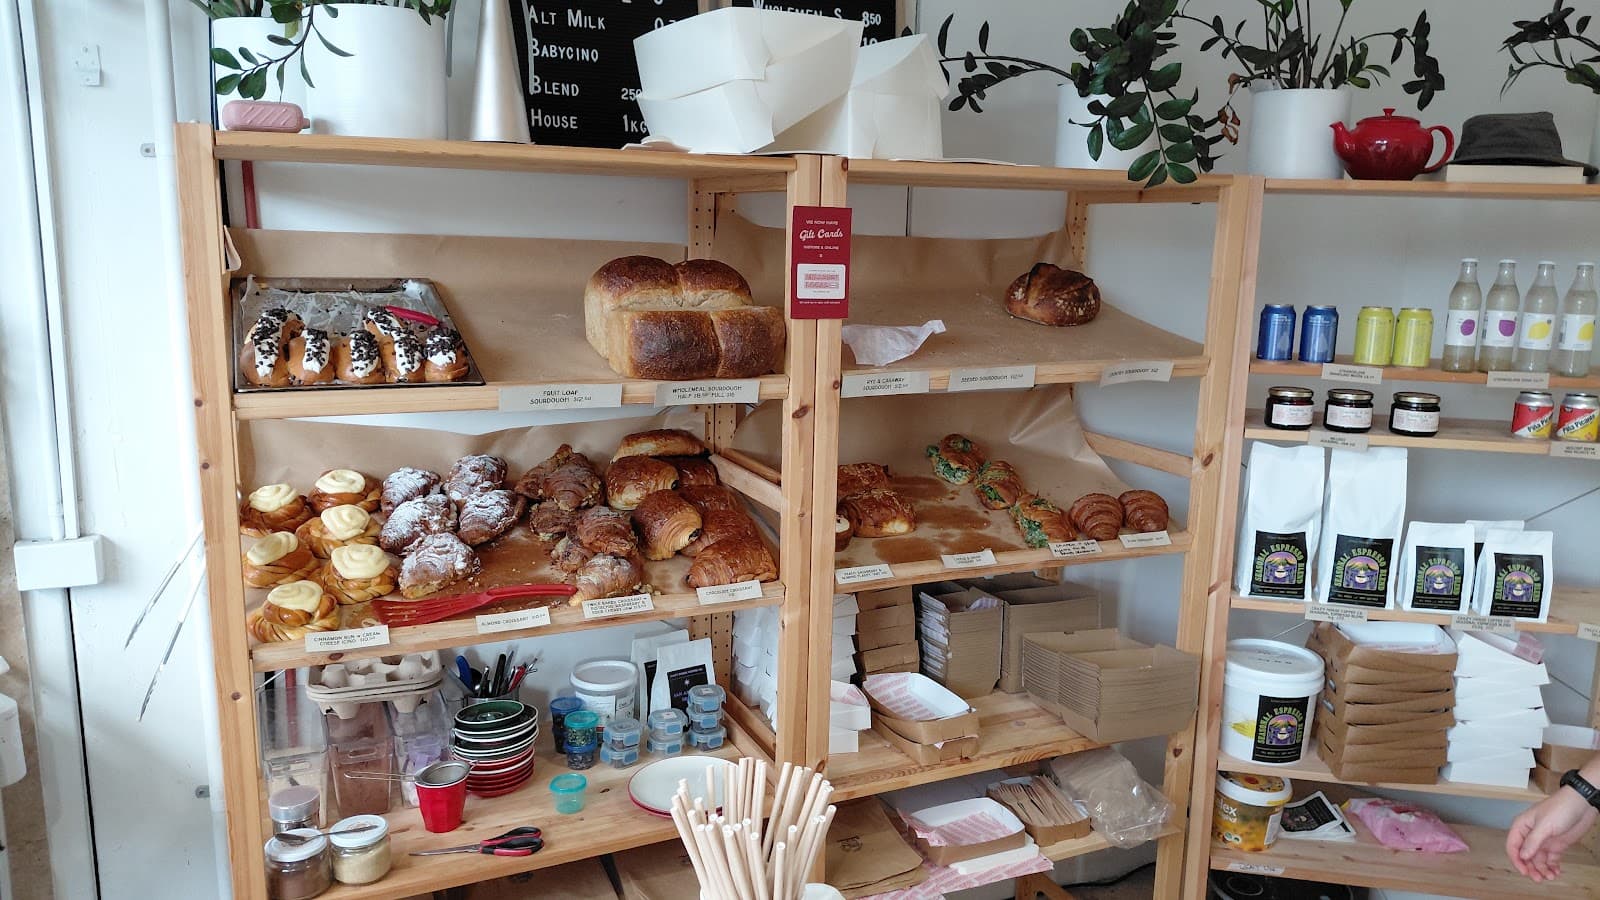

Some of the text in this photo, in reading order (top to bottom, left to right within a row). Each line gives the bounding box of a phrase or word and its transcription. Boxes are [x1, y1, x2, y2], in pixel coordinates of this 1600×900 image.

[529, 5, 557, 26] ALT
[568, 9, 606, 31] MILK
[532, 38, 599, 62] BABYCINO
[532, 75, 580, 97] BLEND
[531, 108, 578, 129] HOUSE
[800, 228, 843, 242] Gift Cards
[529, 397, 570, 405] SOURDOUGH
[1270, 543, 1304, 561] ESPRESSO
[1351, 548, 1387, 567] ESPRESSO
